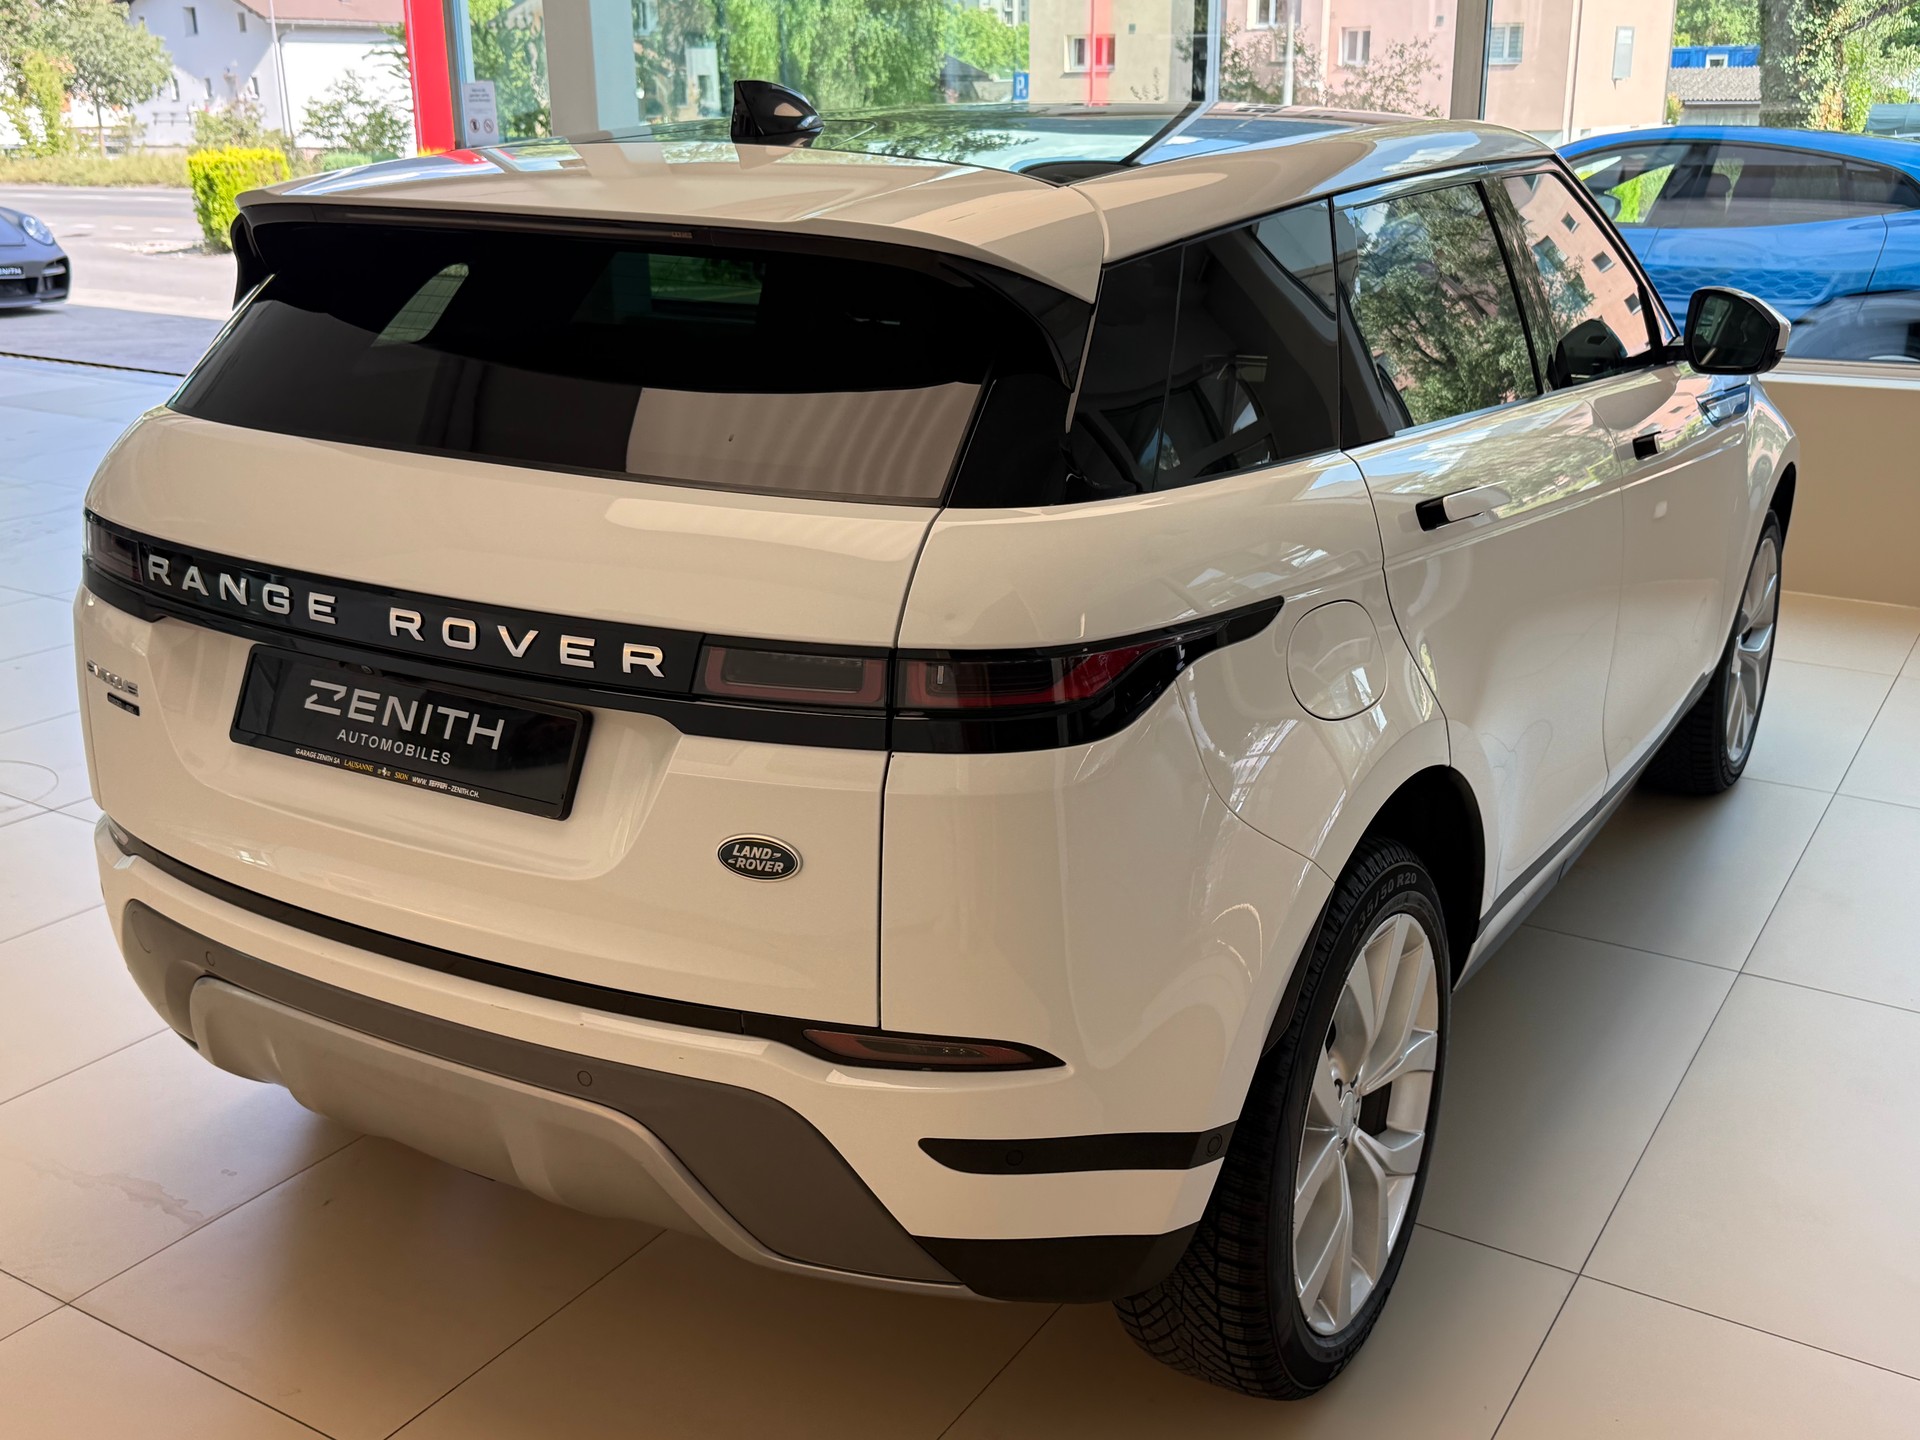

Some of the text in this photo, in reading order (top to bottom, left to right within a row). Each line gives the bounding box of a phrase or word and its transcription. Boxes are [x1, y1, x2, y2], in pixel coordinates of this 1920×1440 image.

[148, 553, 665, 678] RANGE ROVER
[304, 679, 505, 751] ZENITH
[295, 747, 317, 759] GARAGE
[316, 752, 333, 763] ZENITH
[344, 759, 374, 772] LAUSANNE
[394, 771, 409, 781] SION
[336, 728, 451, 765] AUTOMOBILES
[732, 844, 772, 860] LAND
[736, 857, 784, 873] ROVER
[1351, 872, 1417, 945] 235/50 R20
